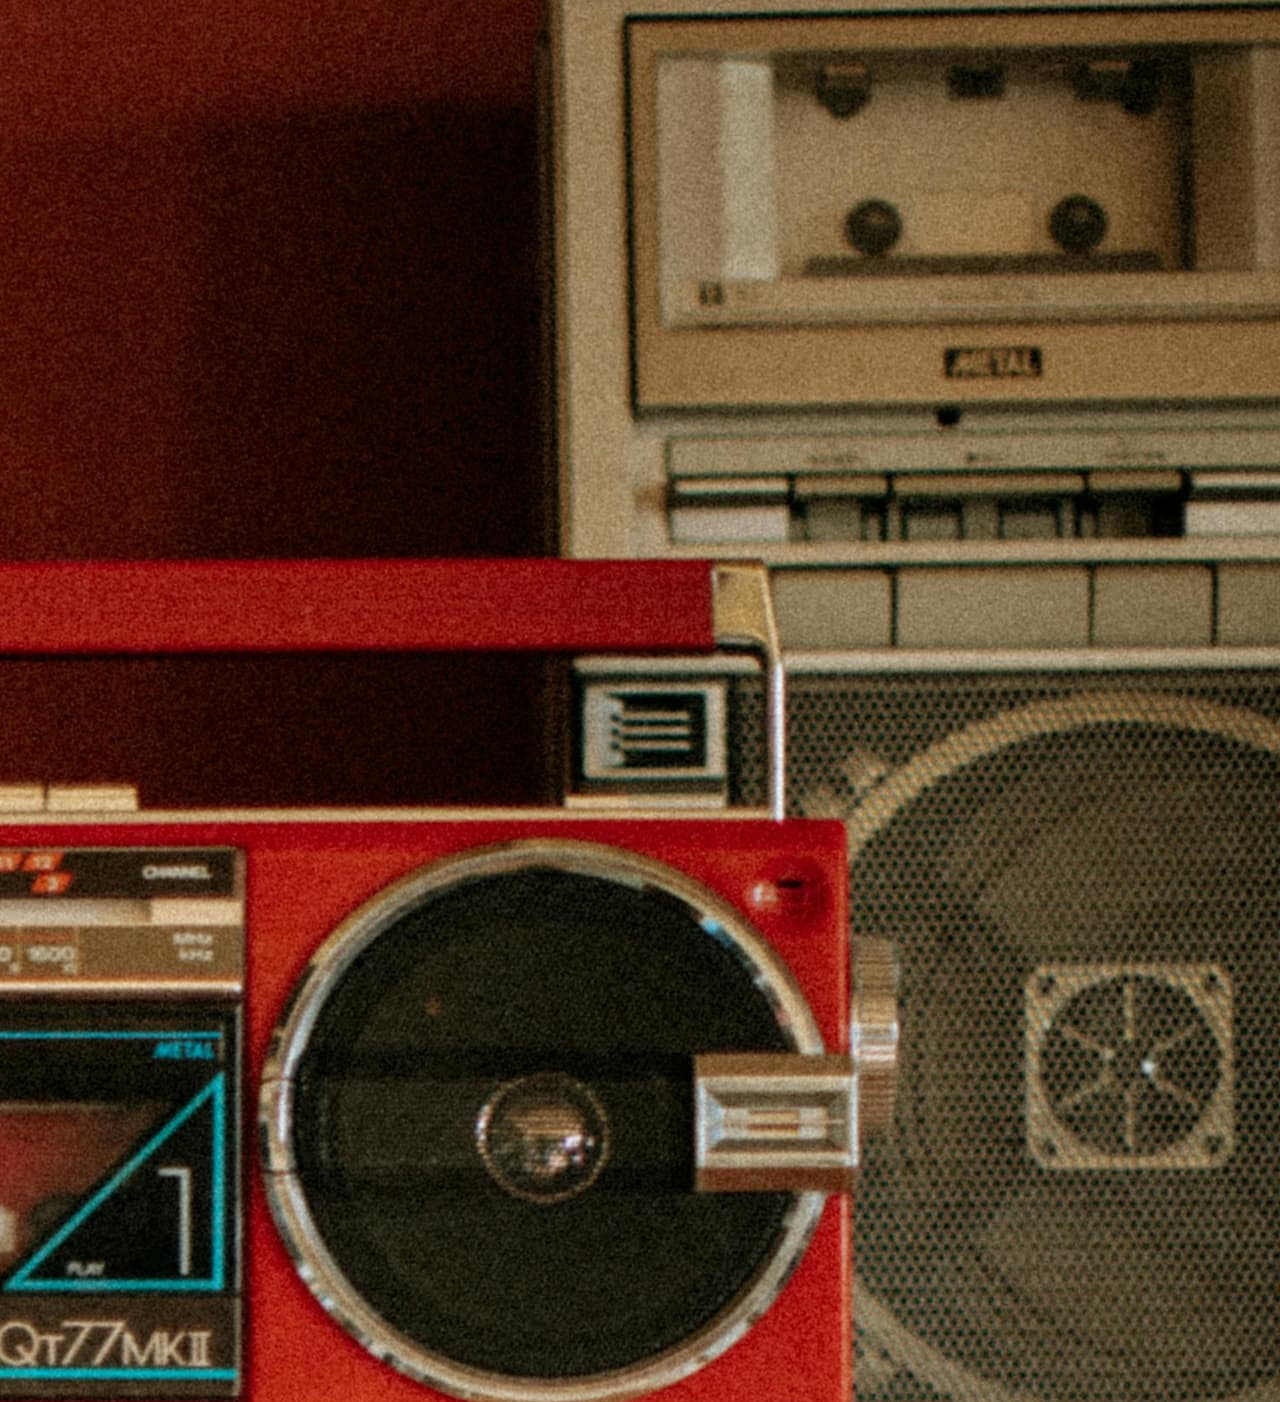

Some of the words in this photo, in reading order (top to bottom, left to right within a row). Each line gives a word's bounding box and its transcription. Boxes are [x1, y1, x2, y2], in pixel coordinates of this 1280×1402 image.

[952, 349, 1034, 375] METAL
[140, 864, 212, 881] CHANNEL
[27, 945, 76, 962] 1600
[152, 1042, 215, 1061] METAL
[157, 1167, 191, 1276] 1
[66, 1259, 107, 1277] PLAY
